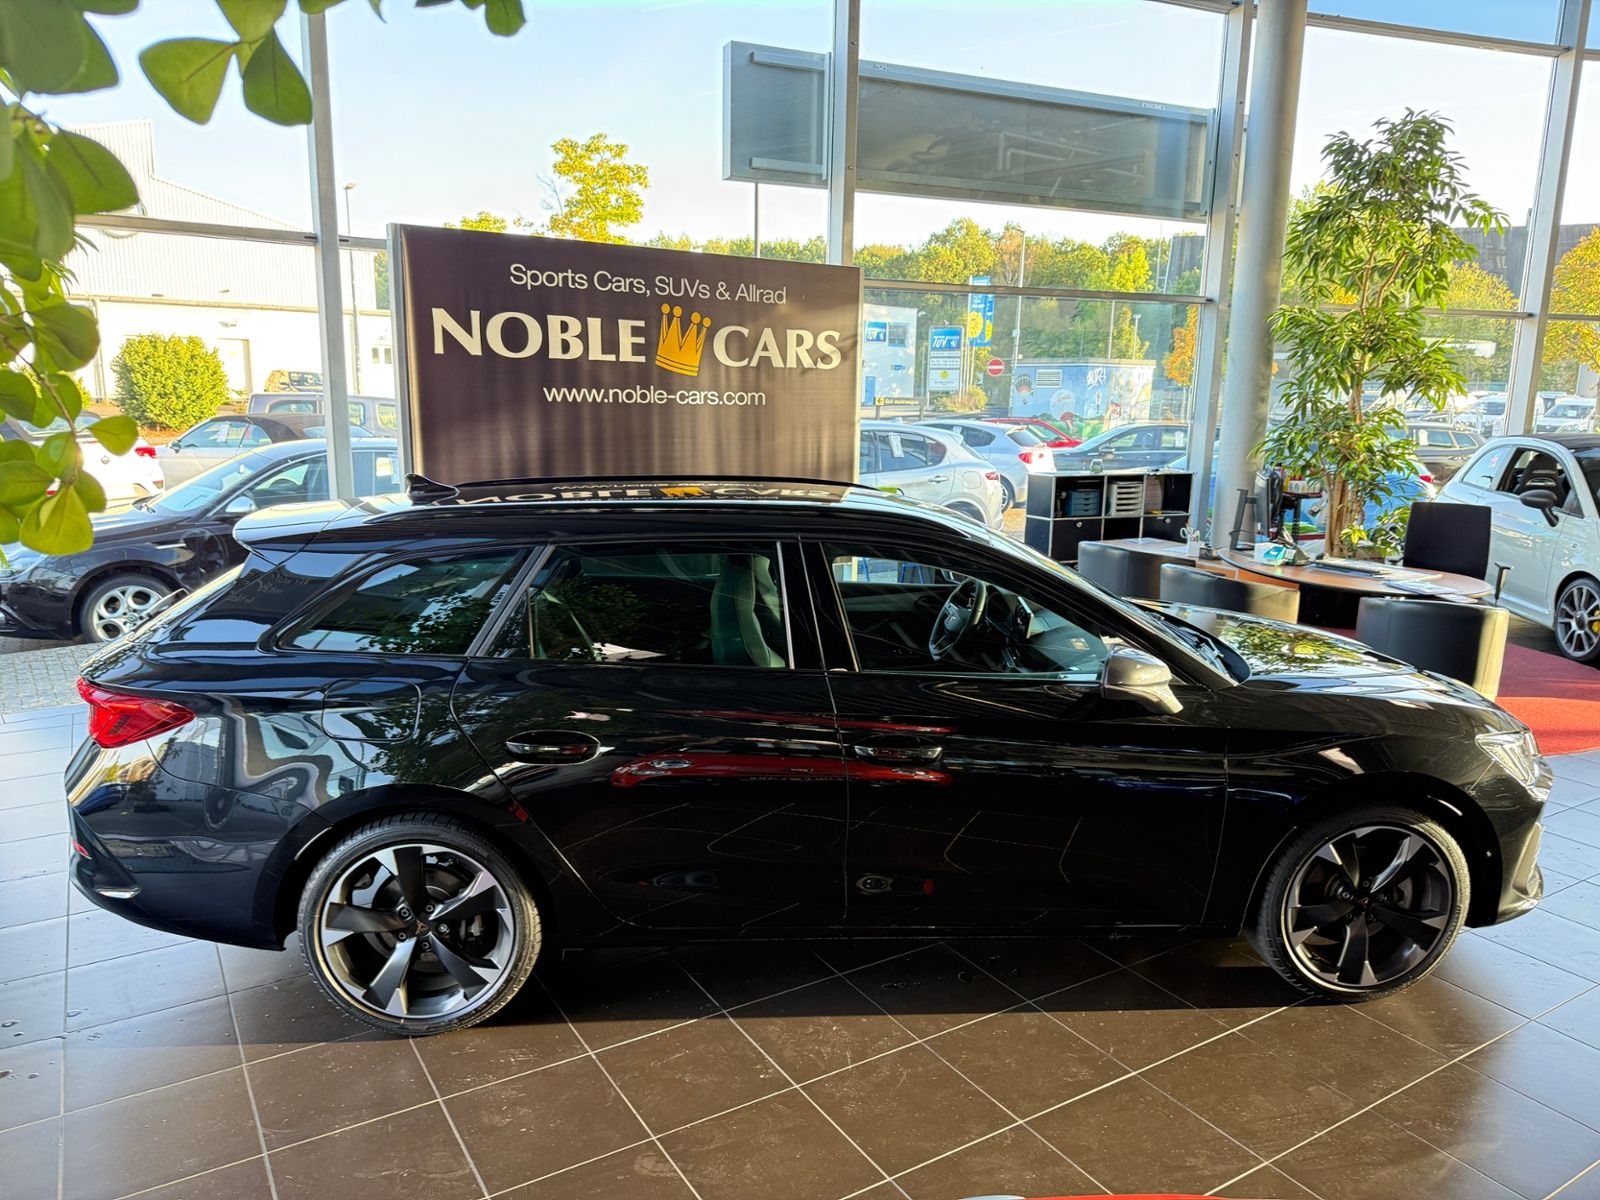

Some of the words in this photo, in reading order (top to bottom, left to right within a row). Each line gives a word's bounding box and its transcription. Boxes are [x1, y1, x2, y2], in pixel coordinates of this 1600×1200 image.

[509, 263, 588, 291] Sports
[593, 271, 651, 298] Cars,
[655, 276, 711, 299] SUVs
[715, 282, 731, 301] &
[735, 283, 787, 305] Allrad
[431, 307, 646, 363] NOBLE
[713, 326, 842, 369] CARS
[543, 385, 766, 406] www.noble-cars.com
